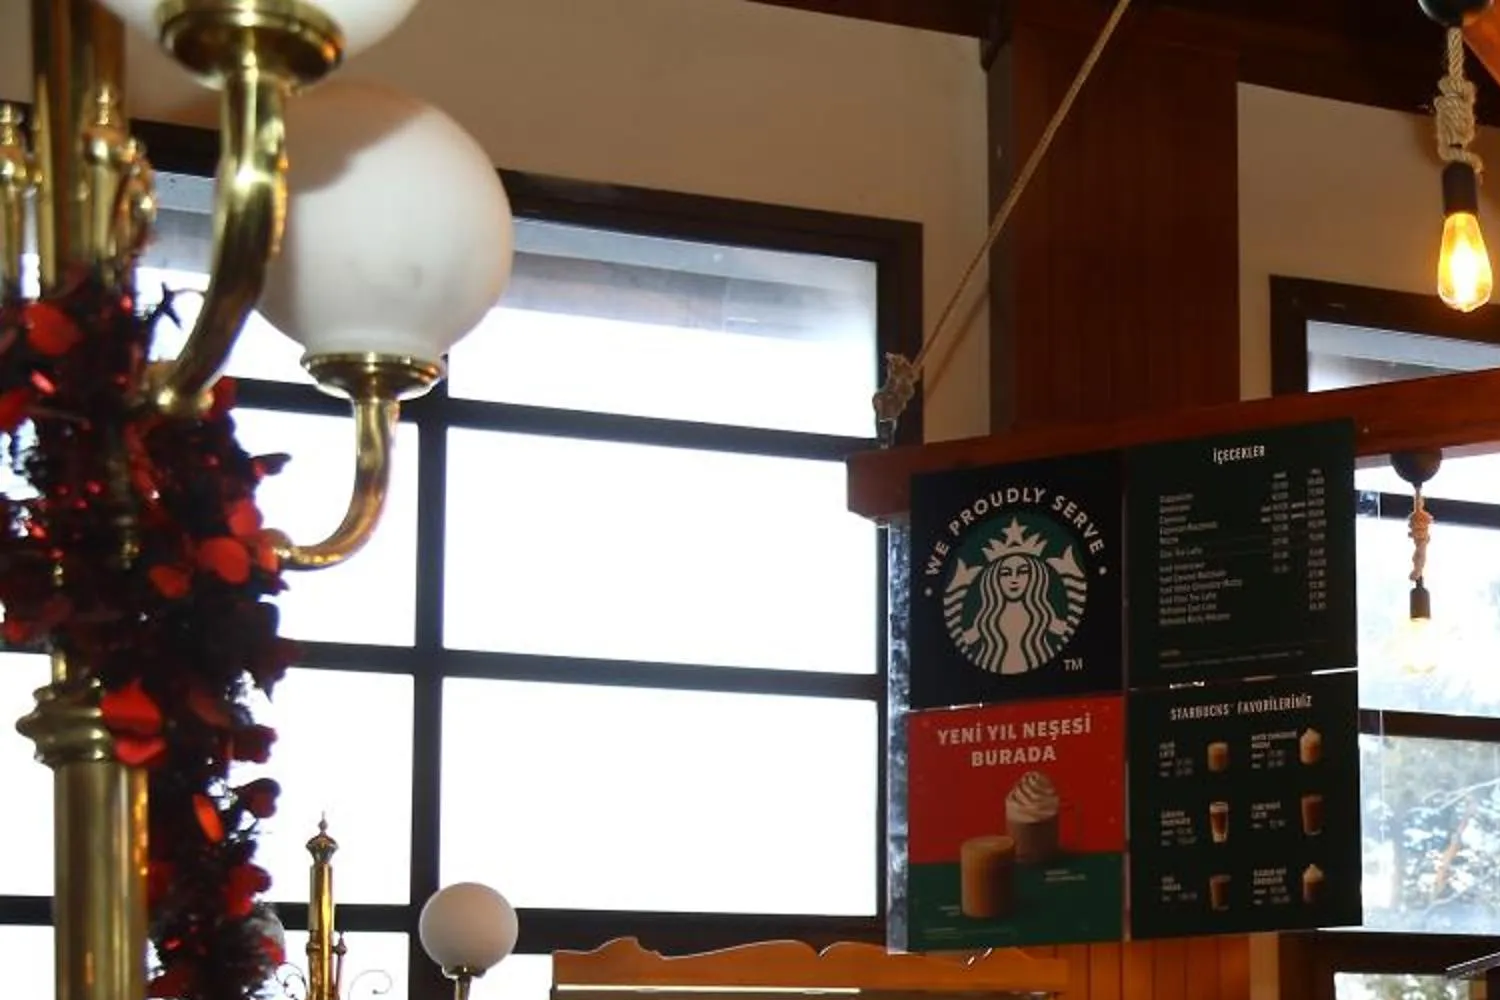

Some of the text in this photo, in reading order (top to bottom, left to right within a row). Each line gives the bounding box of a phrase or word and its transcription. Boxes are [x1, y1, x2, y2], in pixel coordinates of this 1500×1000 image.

[925, 540, 949, 575] WE
[949, 487, 1046, 536] PROUDLY
[1051, 495, 1105, 554] SERVE
[1063, 658, 1083, 671] TM
[937, 712, 1091, 746] YENİ YIL NEŞESİ
[971, 745, 1057, 768] BURADA
